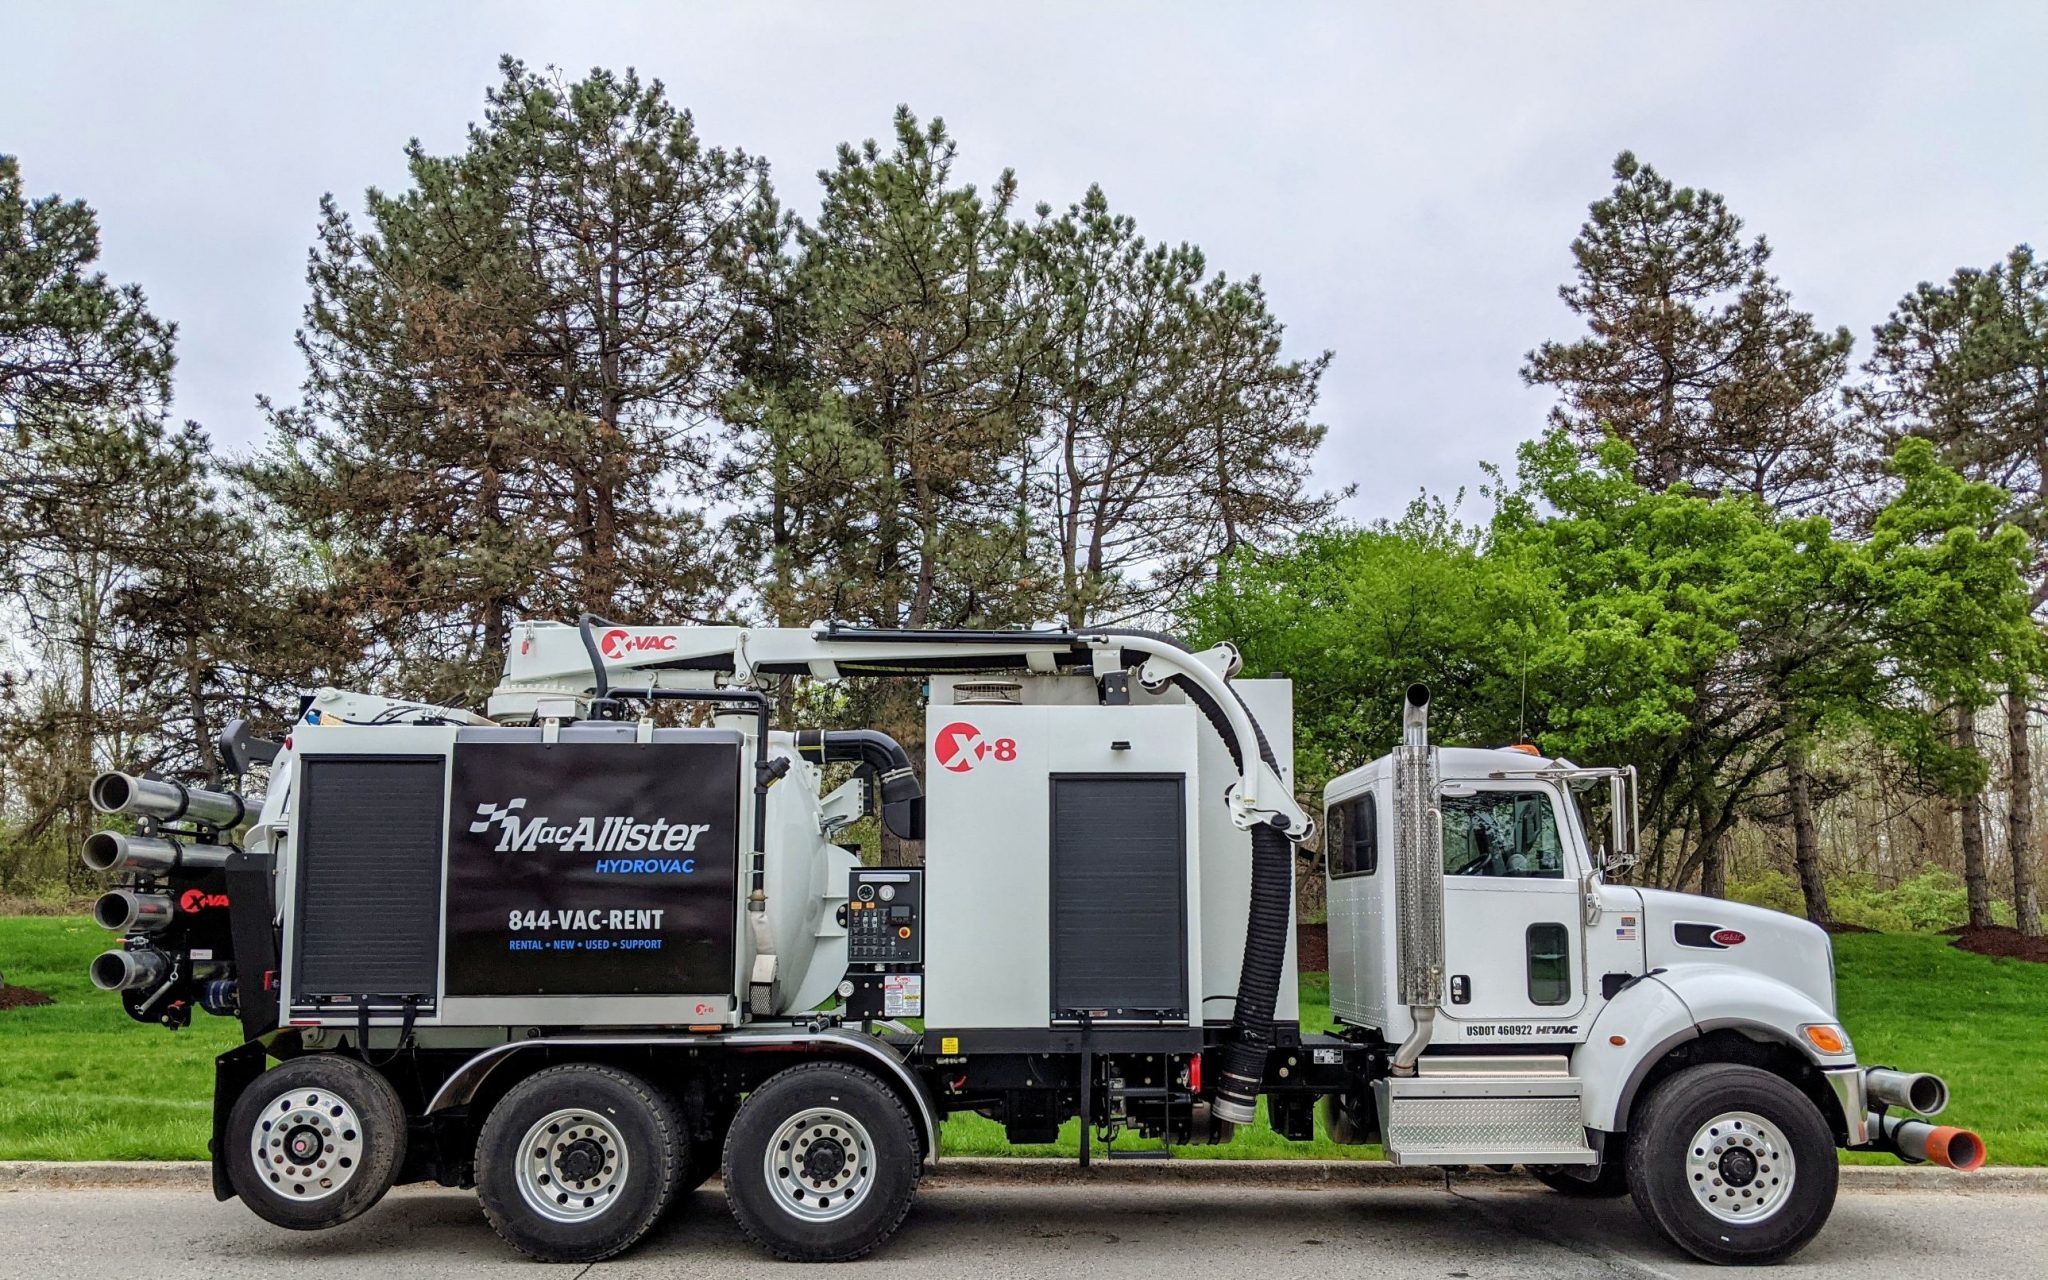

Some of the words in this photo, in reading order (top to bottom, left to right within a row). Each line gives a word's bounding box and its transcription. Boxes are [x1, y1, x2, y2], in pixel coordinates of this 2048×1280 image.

[603, 631, 677, 658] X-VAC
[937, 724, 1016, 771] X-8
[494, 816, 710, 851] MacAllister
[595, 860, 695, 873] HYDROVAC
[181, 889, 229, 912] X-VA
[508, 910, 664, 930] 844-VAC-RENT
[509, 940, 543, 950] RENTAL
[553, 940, 575, 949] NEW
[585, 940, 610, 949] USED
[620, 939, 662, 949] SUPPORT
[1466, 1025, 1495, 1036] USDOT
[1498, 1025, 1532, 1035] 460922
